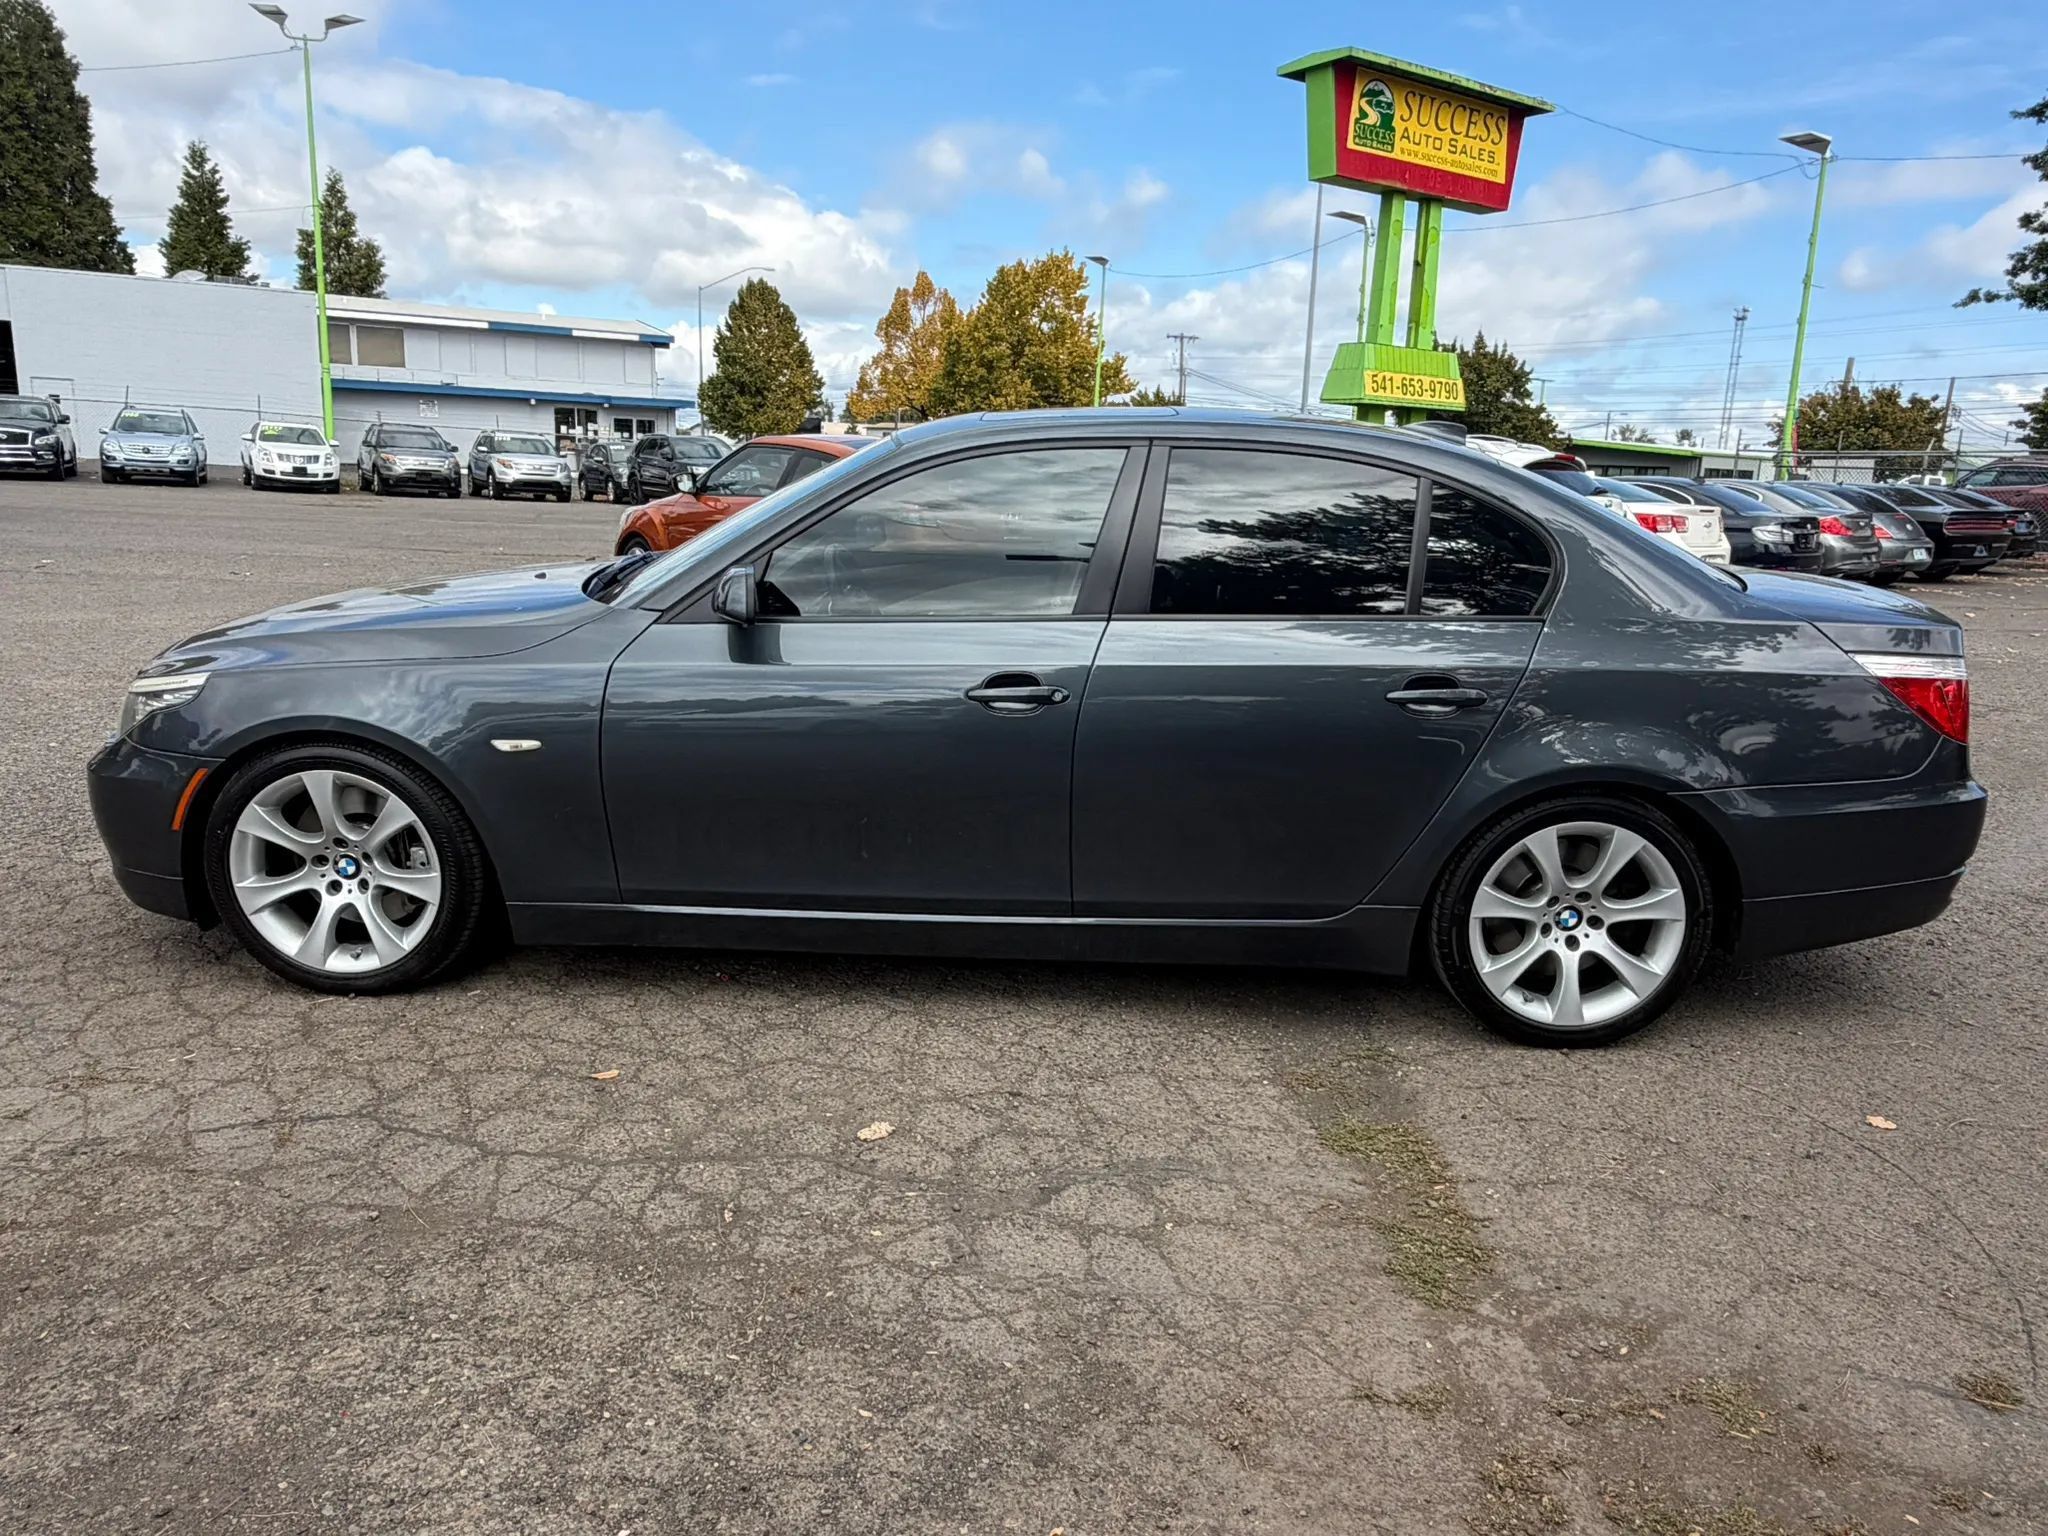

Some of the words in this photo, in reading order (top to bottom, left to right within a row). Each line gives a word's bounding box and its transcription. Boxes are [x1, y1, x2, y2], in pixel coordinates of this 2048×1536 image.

[1354, 123, 1396, 144] SUCCESS
[1400, 90, 1506, 146] SUCCESS
[1400, 127, 1443, 151] AUTO
[1449, 138, 1496, 165] SALES
[1400, 147, 1498, 178] www.success-autosales.com
[1371, 374, 1459, 400] 541-653-9790
